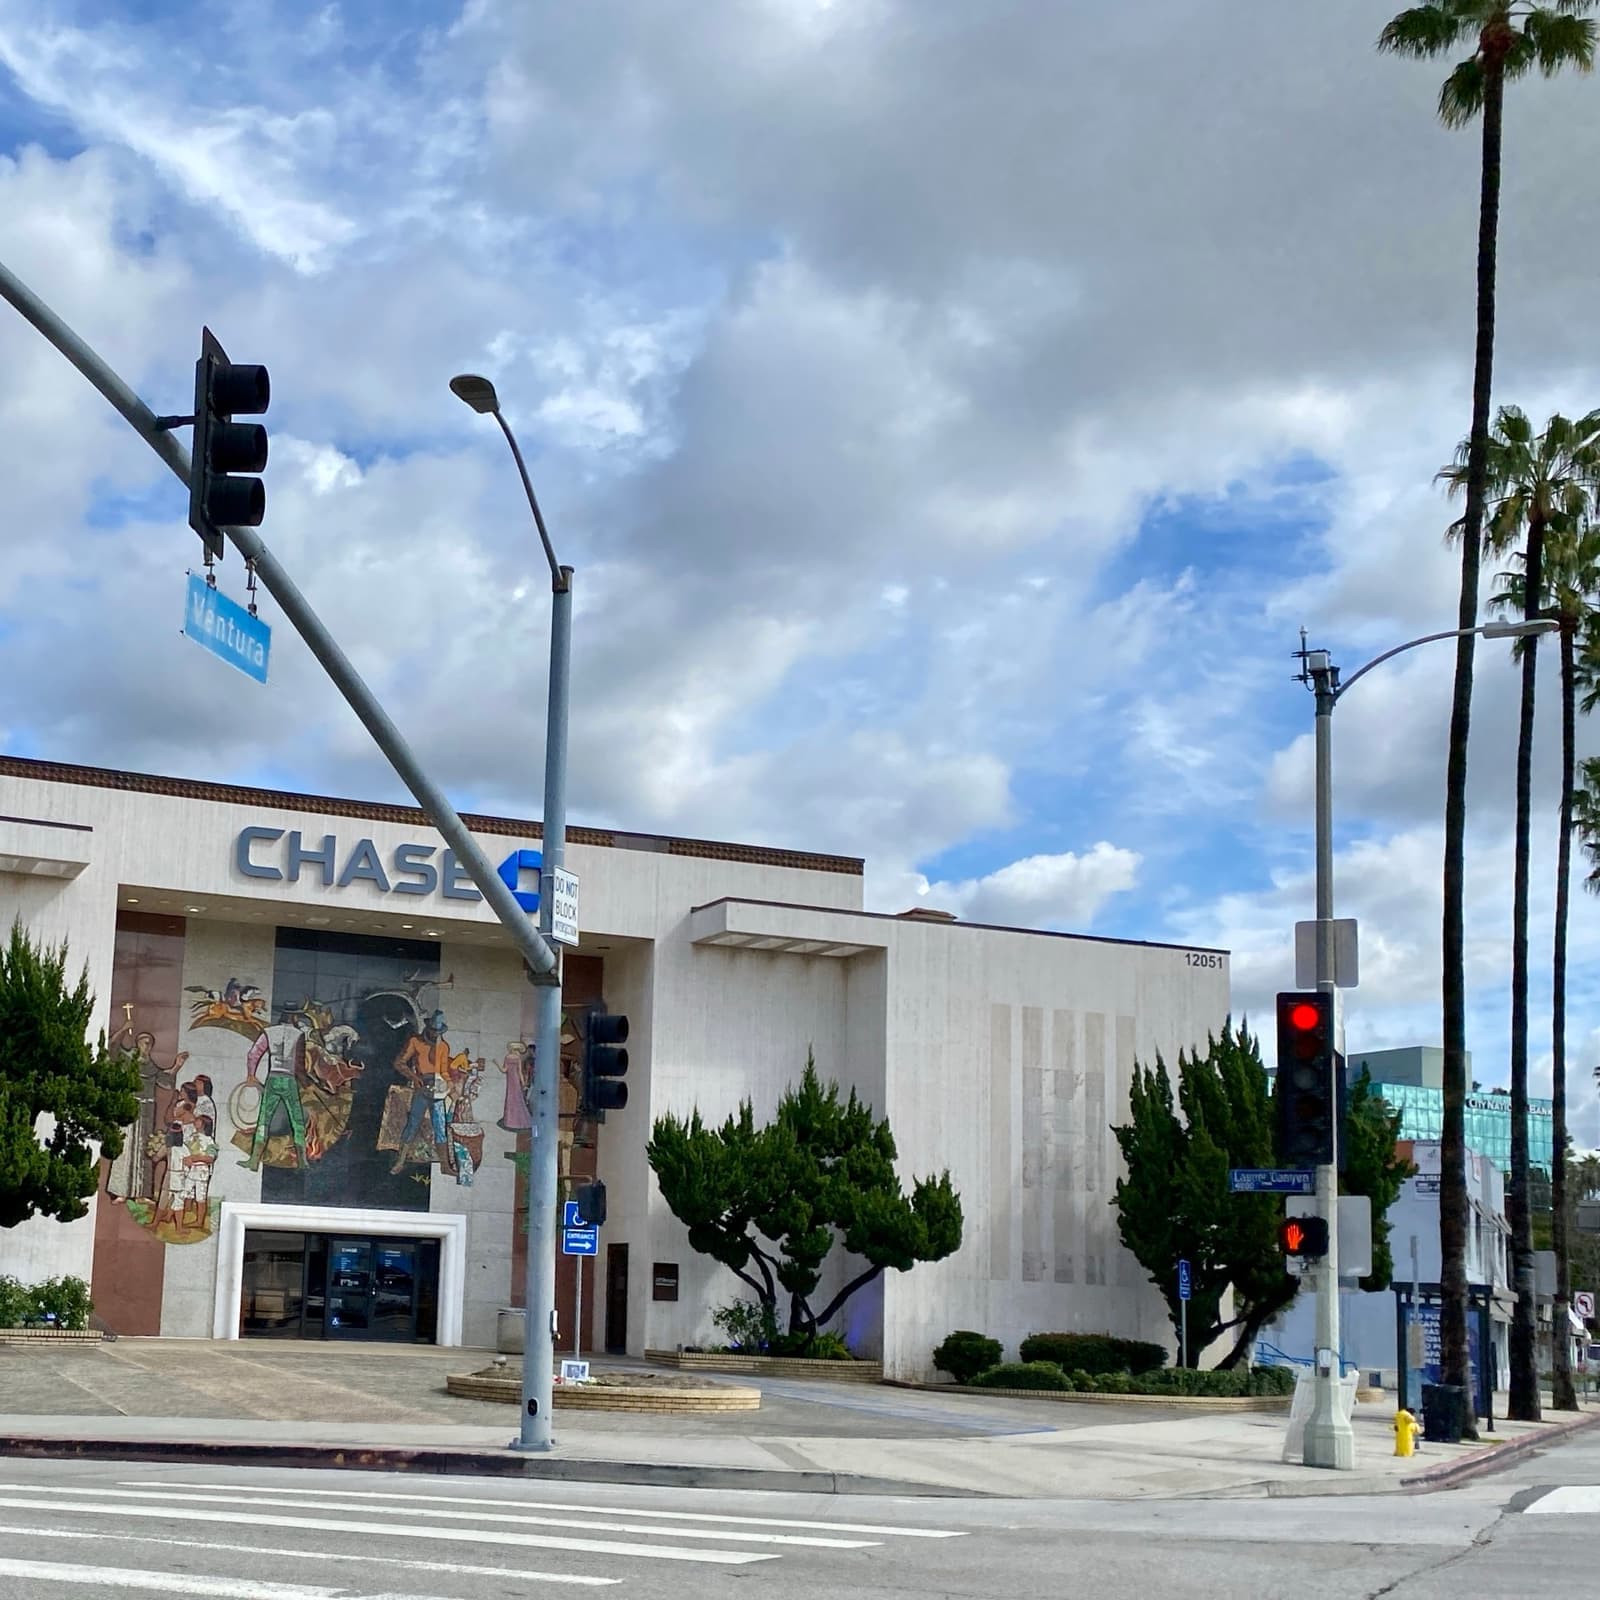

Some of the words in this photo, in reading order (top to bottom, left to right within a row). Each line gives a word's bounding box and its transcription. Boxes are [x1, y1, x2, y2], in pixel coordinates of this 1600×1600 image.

[192, 591, 264, 667] Ventura
[236, 826, 484, 901] CHASE
[556, 876, 564, 894] DO
[566, 880, 578, 899] NOT
[556, 900, 577, 921] BLOCK
[1185, 953, 1222, 969] 12051
